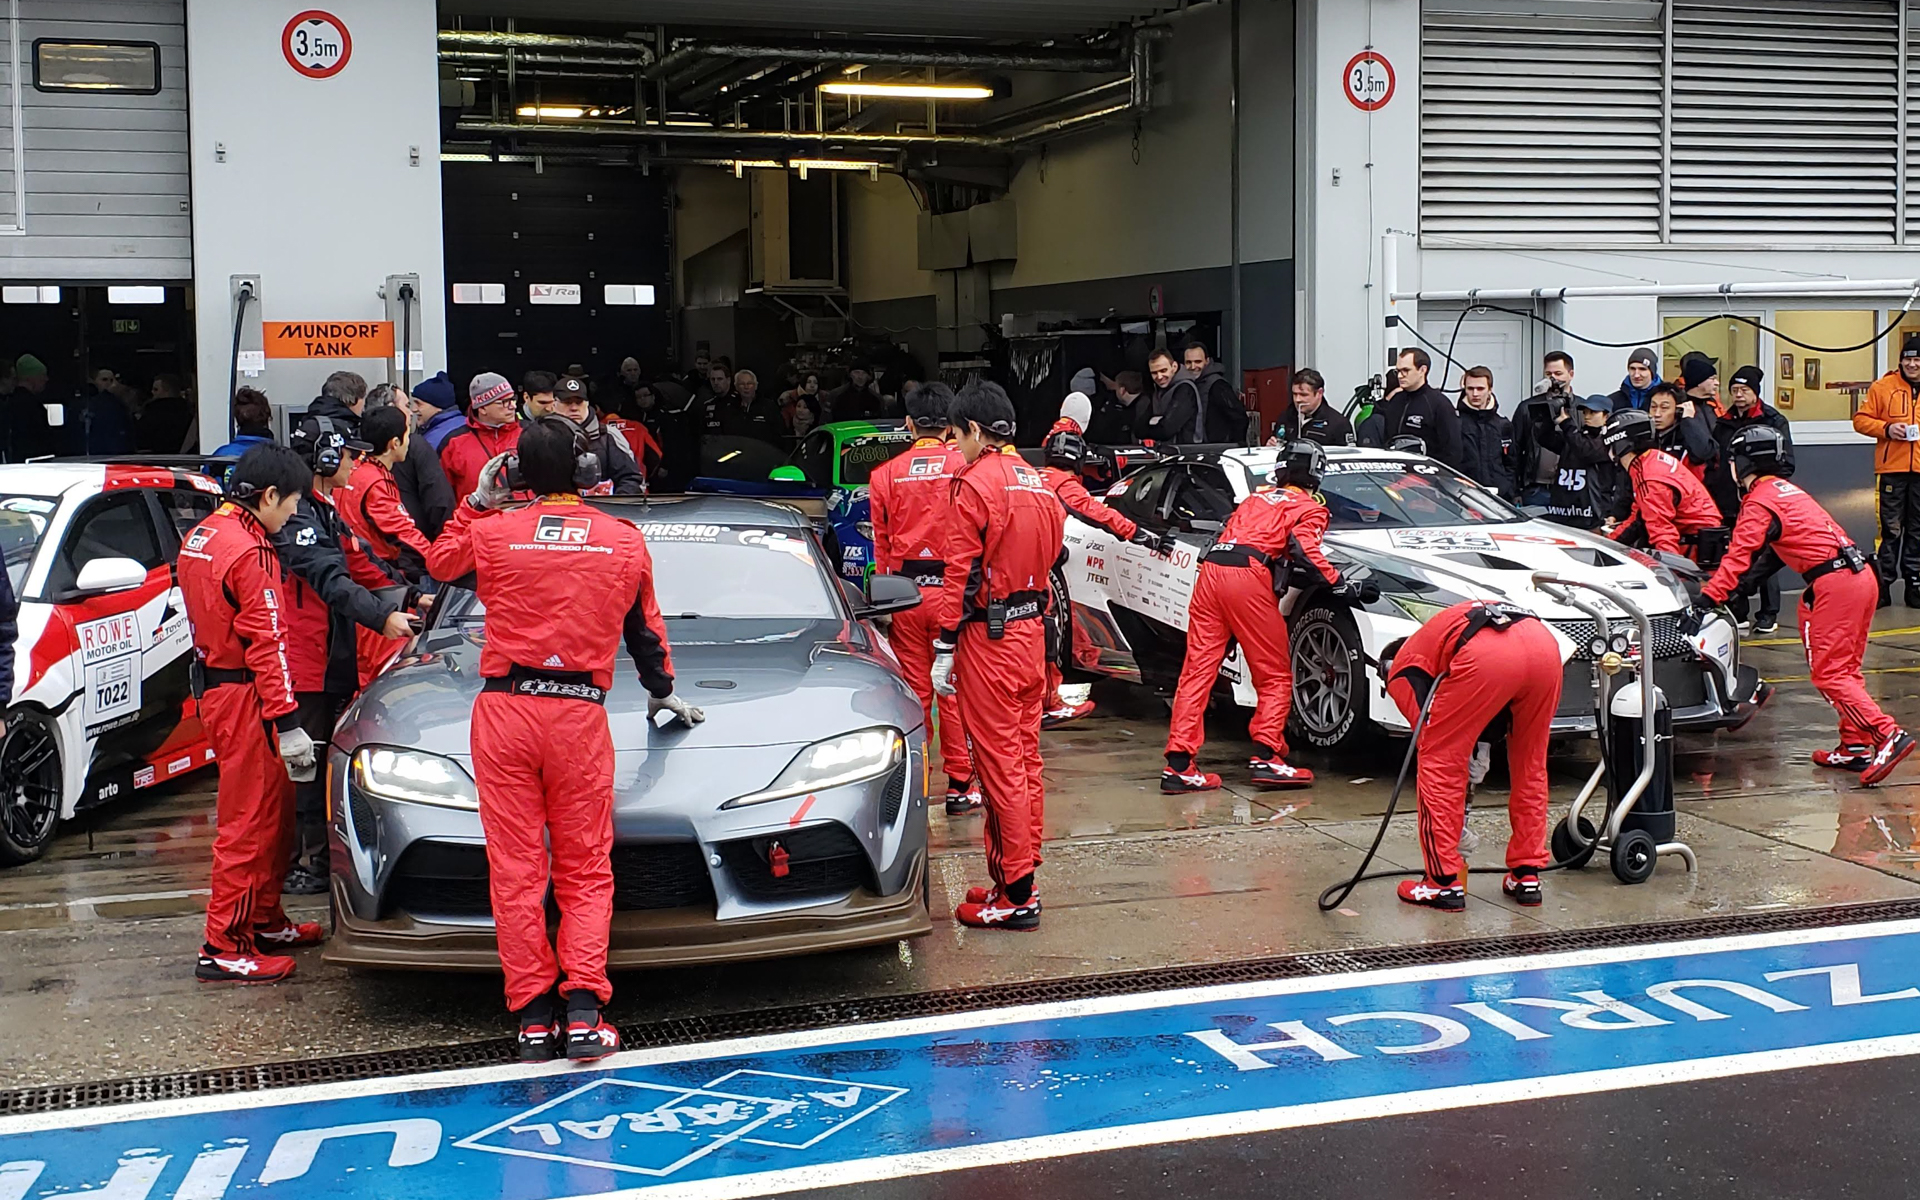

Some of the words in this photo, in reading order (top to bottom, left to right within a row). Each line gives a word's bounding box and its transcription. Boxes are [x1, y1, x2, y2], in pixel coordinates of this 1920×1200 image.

[296, 29, 338, 57] 3,5m
[1353, 68, 1385, 93] 3,5m
[278, 324, 378, 338] MUNDORF
[305, 342, 352, 356] TANK
[1603, 430, 1628, 446] uvex
[911, 463, 942, 475] GR
[1341, 461, 1405, 471] TURISMO
[537, 525, 586, 542] GR
[635, 524, 721, 537] URISMO
[1399, 535, 1492, 547] 345
[1086, 555, 1105, 570] NPR
[1086, 571, 1110, 586] JTEKT
[84, 617, 133, 650] ROWE
[86, 642, 118, 660] MOTOR
[119, 639, 133, 650] OIL
[97, 681, 128, 709] T022
[98, 782, 119, 800] arto
[1182, 962, 1920, 1072] ZURICH
